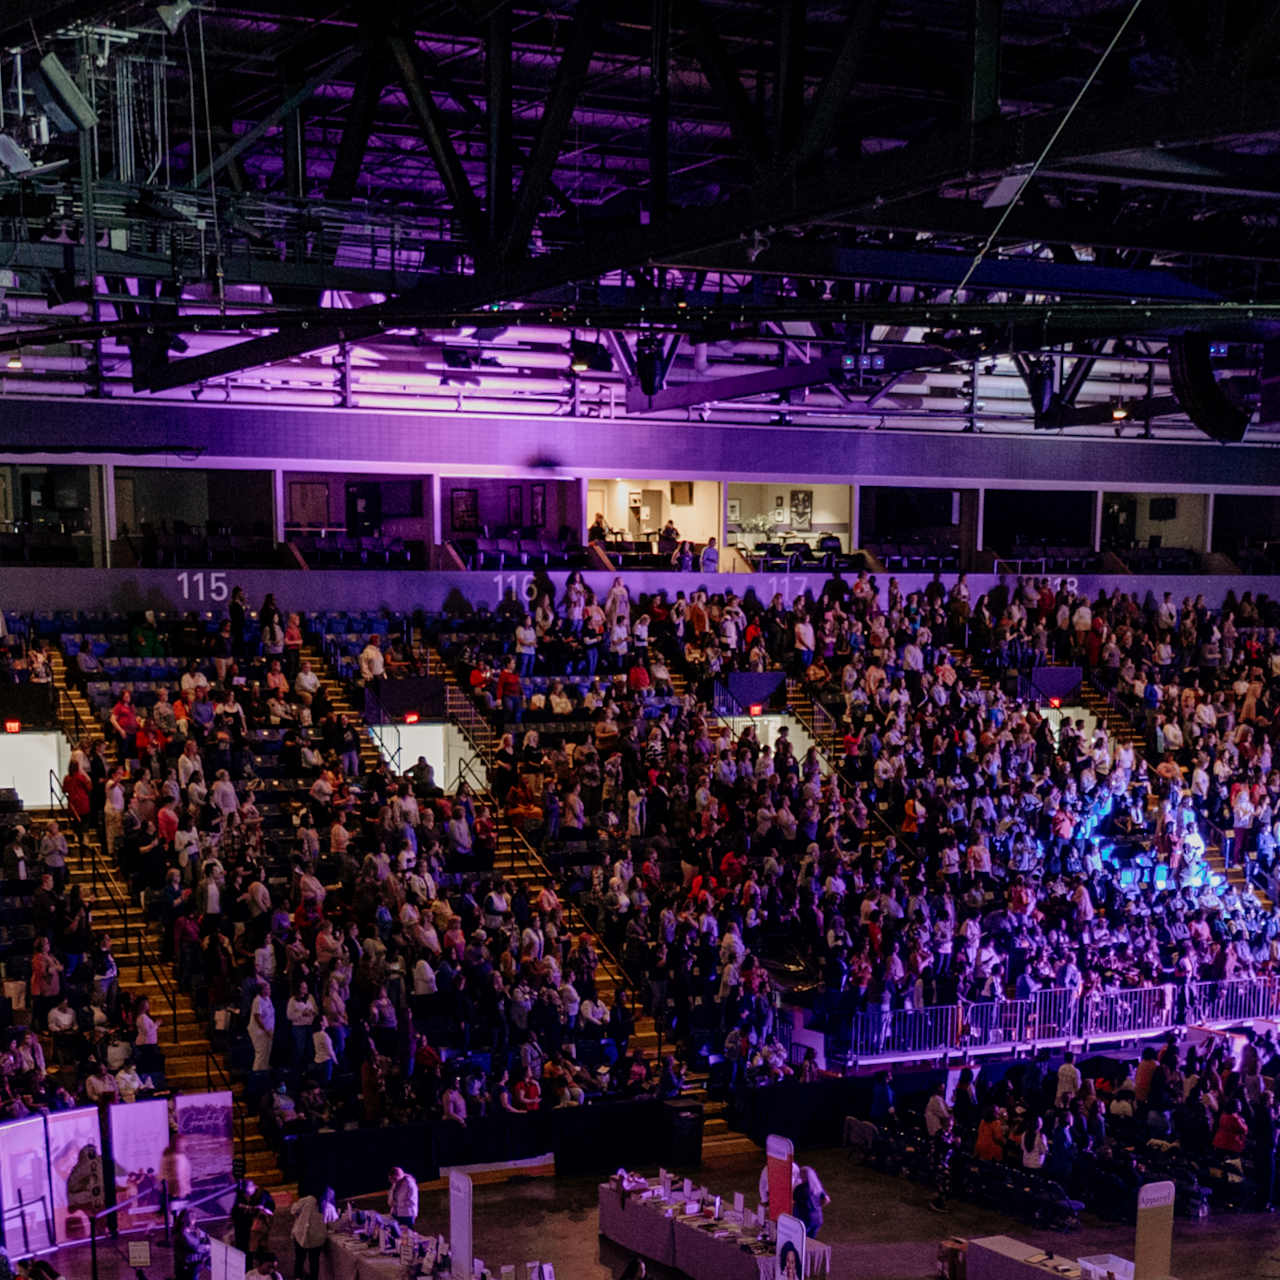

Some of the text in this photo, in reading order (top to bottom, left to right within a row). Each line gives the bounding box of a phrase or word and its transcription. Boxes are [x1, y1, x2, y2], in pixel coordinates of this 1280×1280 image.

[177, 572, 228, 601] 115
[493, 574, 538, 601] 116
[768, 576, 808, 600] 117
